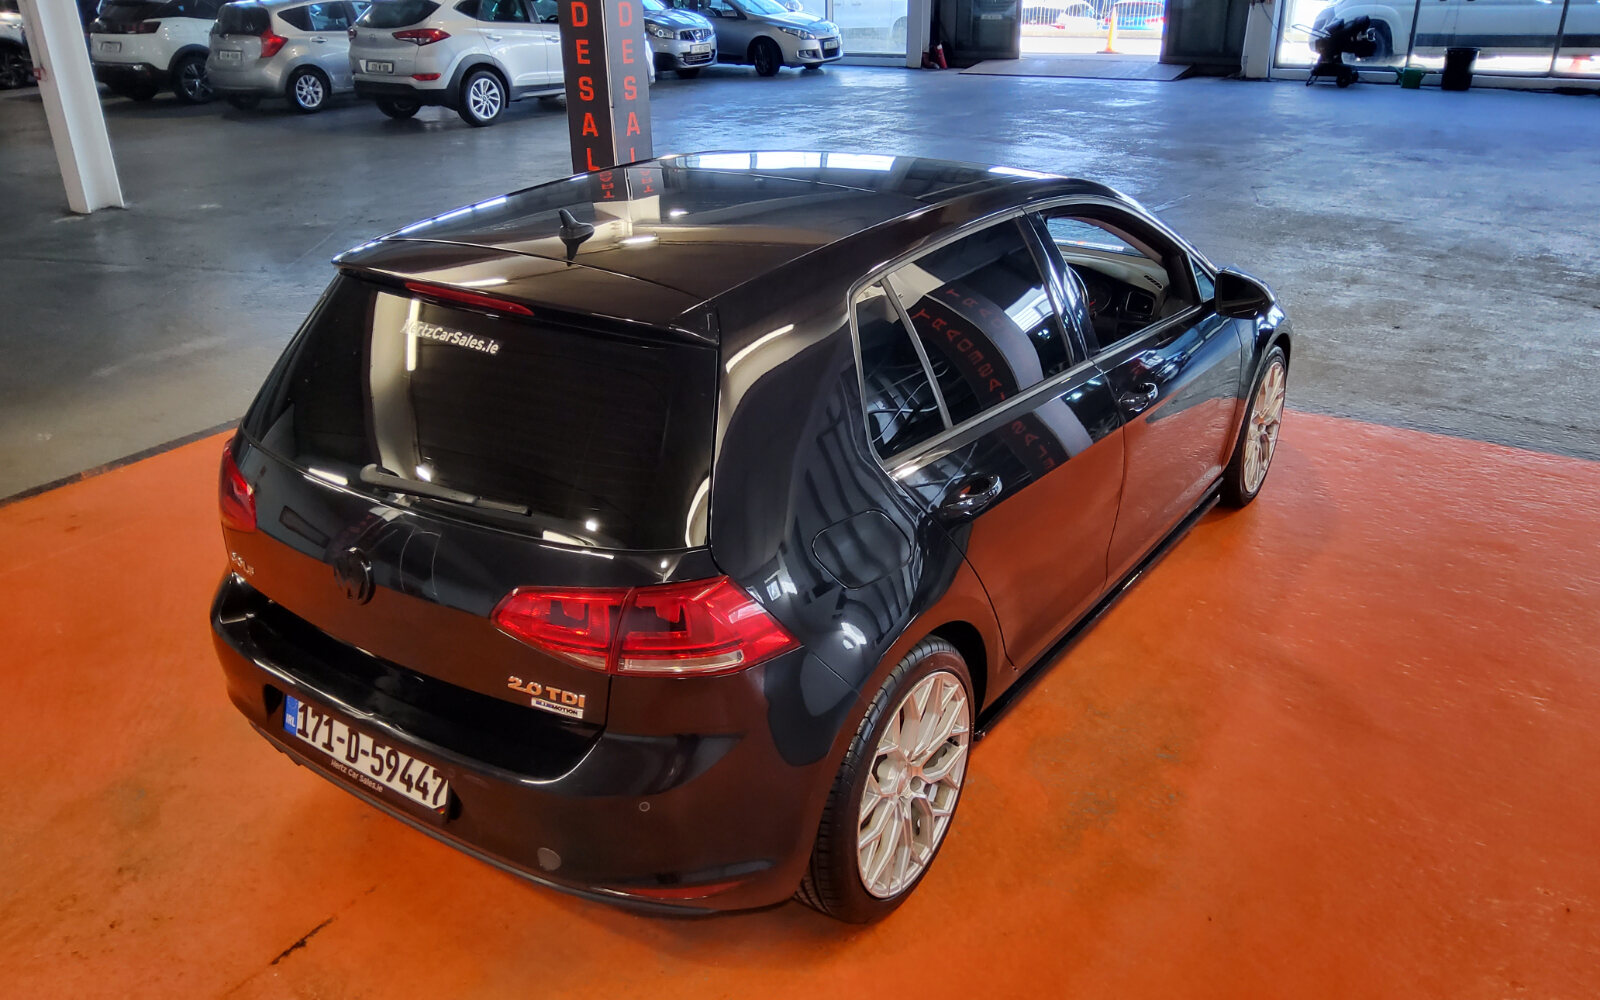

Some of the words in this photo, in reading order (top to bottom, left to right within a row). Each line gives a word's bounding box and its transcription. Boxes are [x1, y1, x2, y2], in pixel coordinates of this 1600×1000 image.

[400, 319, 500, 355] HertzCarSales.ie
[507, 675, 543, 697] 2.0
[545, 685, 586, 708] TDI
[298, 702, 448, 806] 171-D-59447
